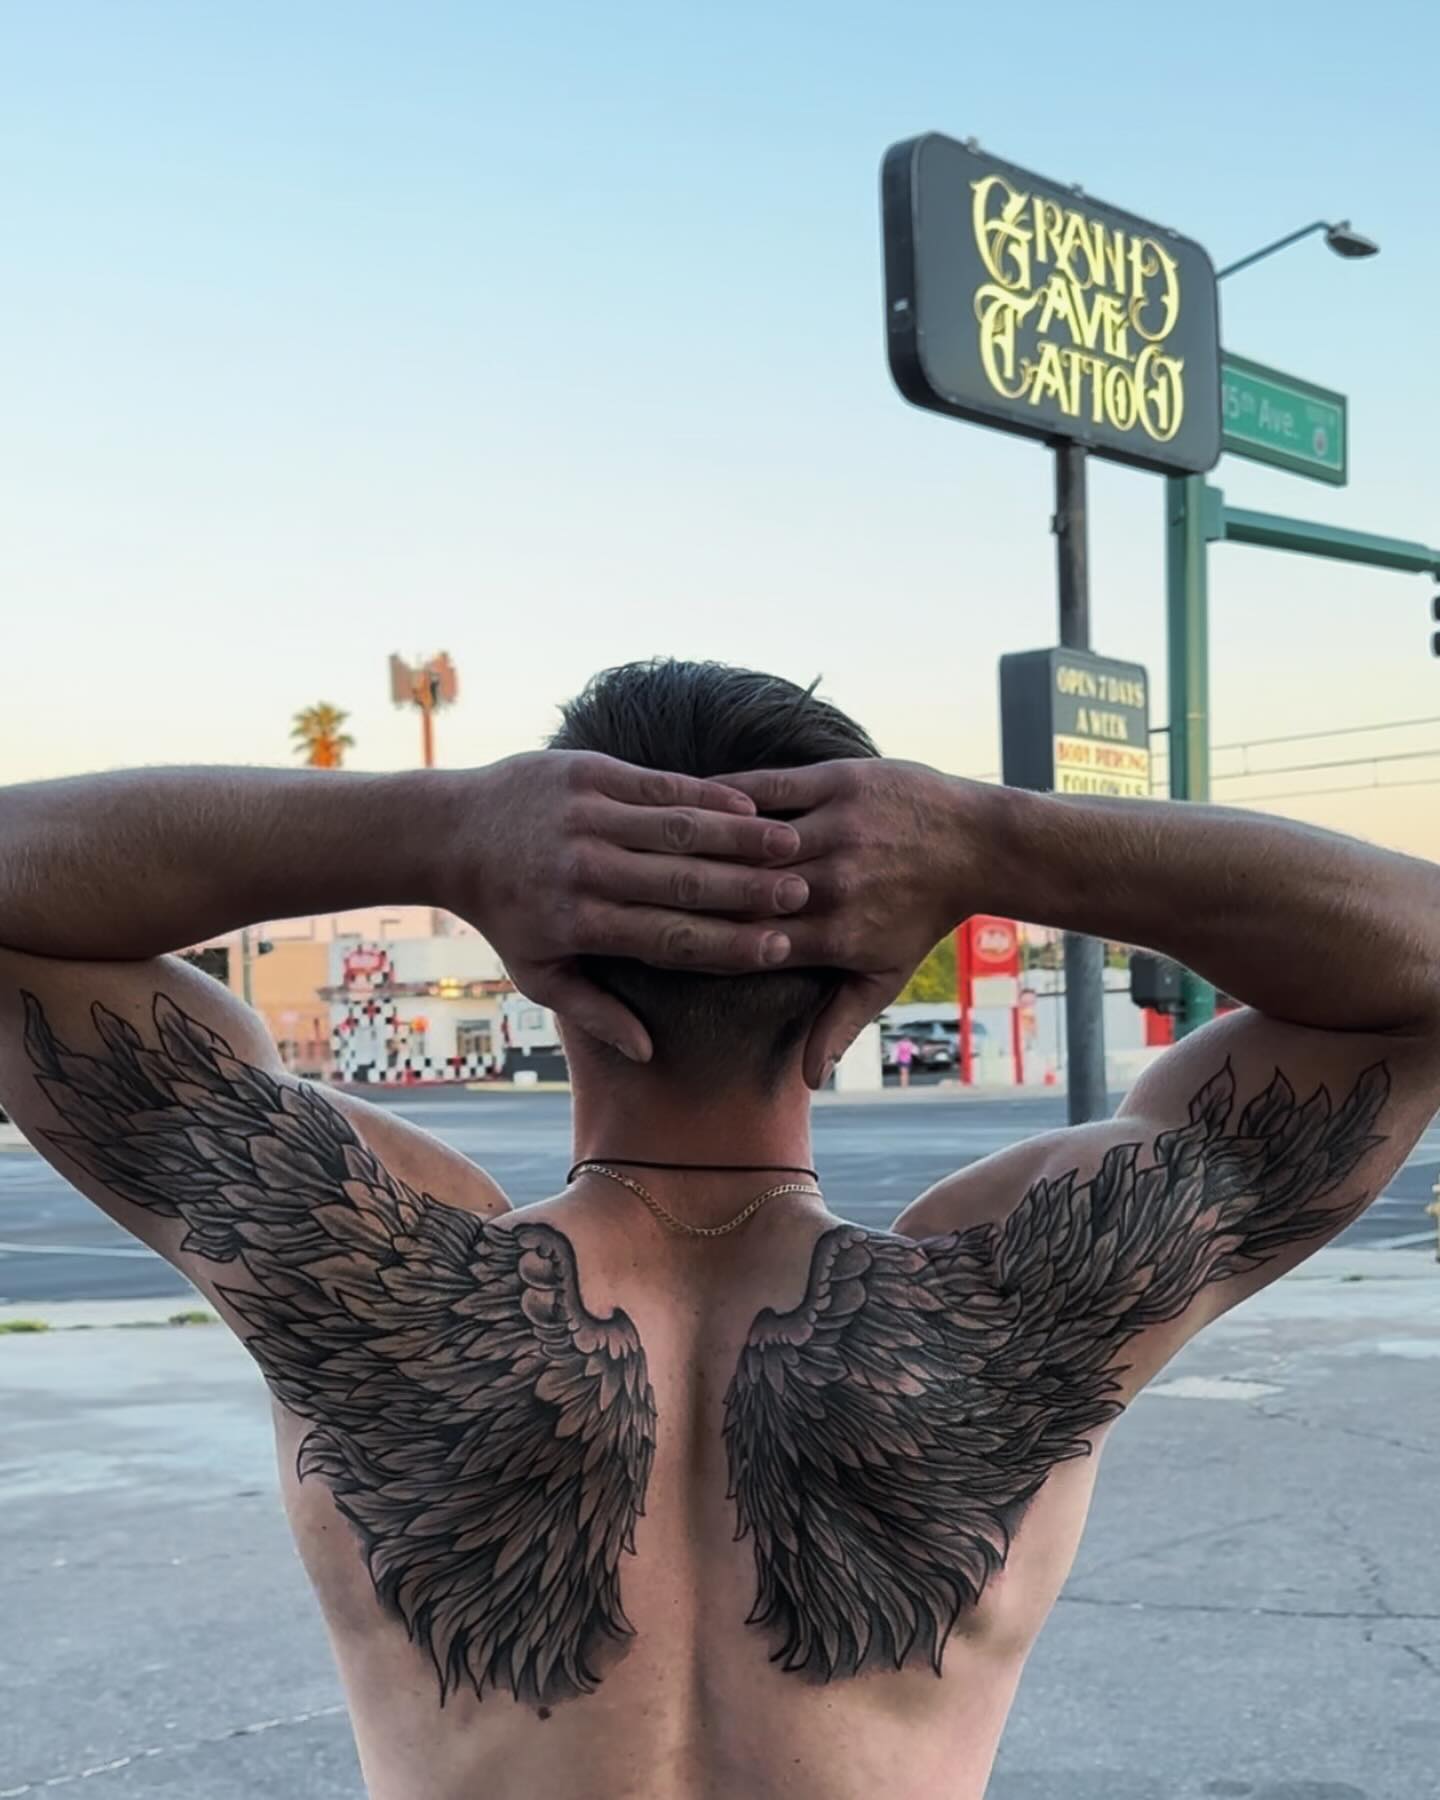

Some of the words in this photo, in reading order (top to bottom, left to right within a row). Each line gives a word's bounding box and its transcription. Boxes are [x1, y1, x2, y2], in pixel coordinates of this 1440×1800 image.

[970, 175, 1179, 341] GRAND
[974, 284, 1183, 441] TATTOO
[1056, 666, 1096, 698] OPEN
[1098, 676, 1107, 701] 7
[1108, 678, 1144, 709] DAYS
[1076, 707, 1089, 734] A
[1090, 710, 1129, 741] WEEK
